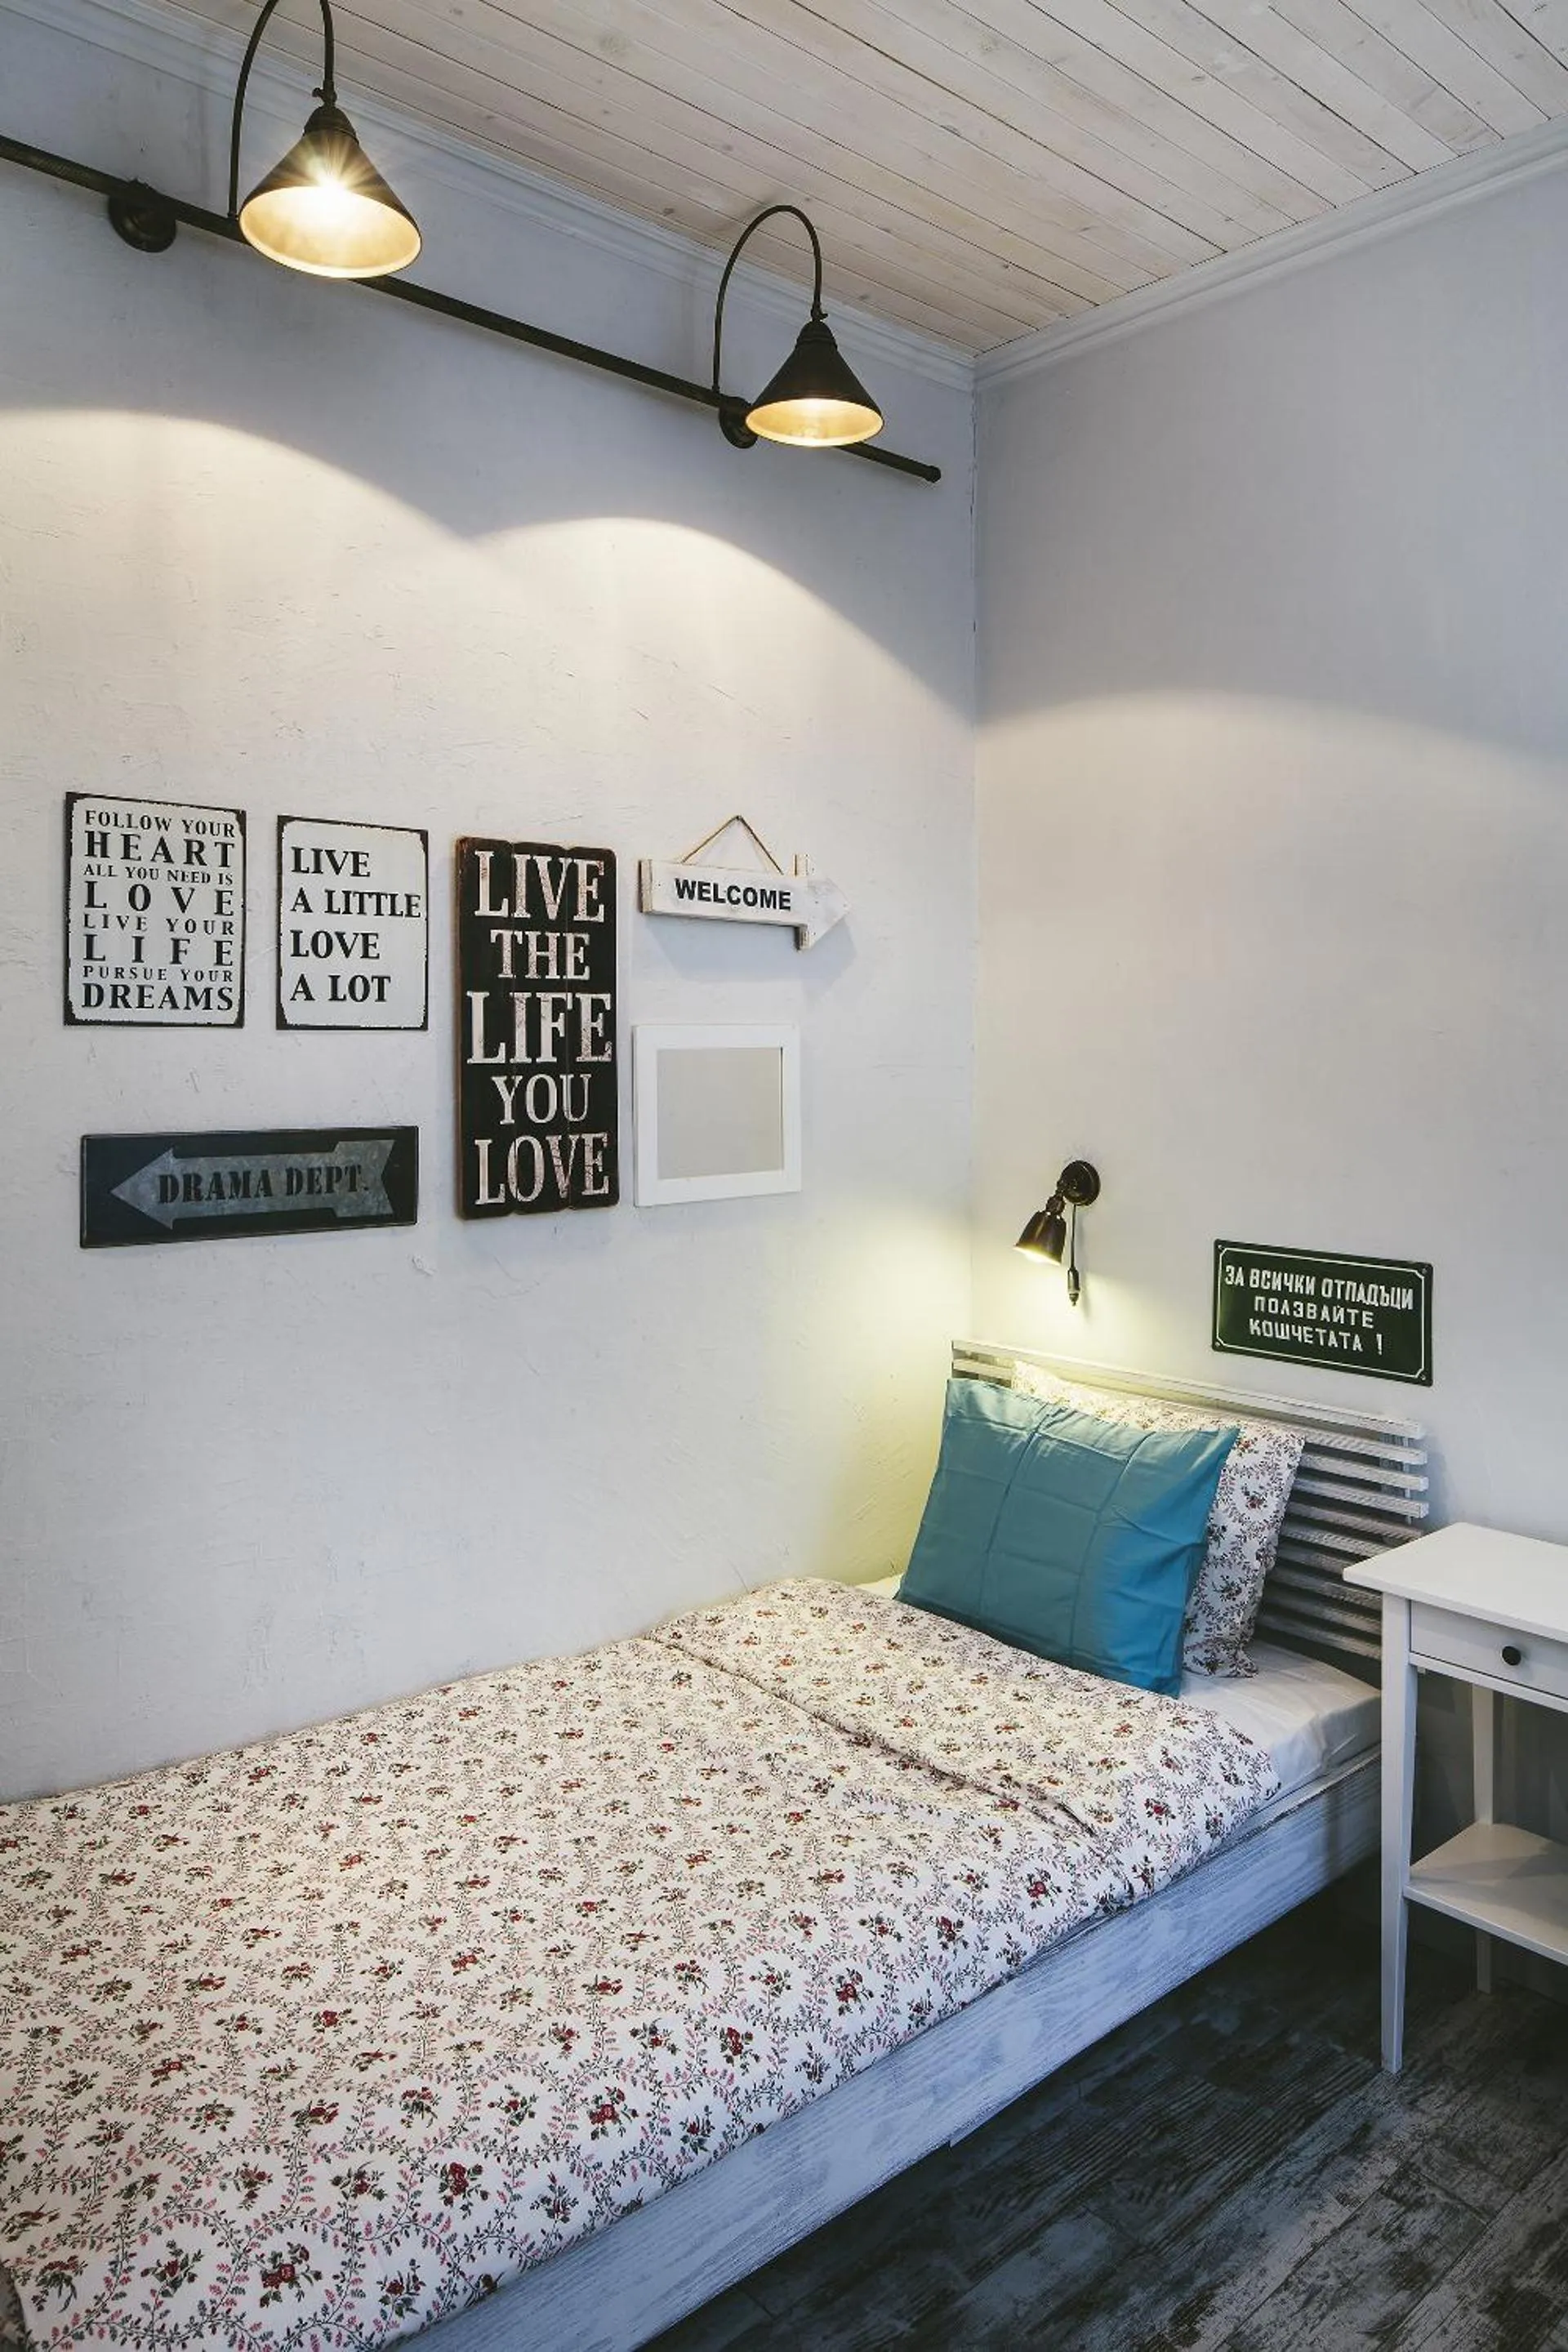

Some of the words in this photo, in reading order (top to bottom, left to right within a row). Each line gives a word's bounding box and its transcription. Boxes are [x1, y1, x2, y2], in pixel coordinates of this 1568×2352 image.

[85, 810, 172, 831] FOLLOW
[182, 820, 234, 838] YOUR
[84, 831, 234, 867] HEART
[292, 847, 370, 877] LIVE
[83, 864, 118, 877] ALL
[125, 866, 159, 880] YOU
[167, 870, 210, 884] NEED
[218, 874, 233, 885] IS
[474, 851, 605, 922] LIVE
[84, 880, 234, 916] LOVE
[290, 887, 313, 913] A
[324, 889, 421, 918] LITTLE
[675, 878, 791, 911] WELCOME
[83, 914, 148, 931] LIVE
[166, 919, 234, 935] YOUR
[83, 934, 233, 966] LIFE
[290, 929, 380, 959] LOVE
[490, 929, 590, 980] THE
[83, 966, 167, 981] PURSUE
[181, 969, 233, 982] YOUR
[290, 973, 315, 1001] A
[328, 974, 390, 1002] LOT
[82, 983, 234, 1010] DREAMS
[466, 991, 612, 1063] LIFE
[492, 1074, 592, 1125] YOU
[474, 1133, 609, 1205] LOVE
[157, 1169, 273, 1204] DRAMA
[1225, 1265, 1244, 1286] ЗА
[1250, 1268, 1316, 1296] ВСИЧКИ
[1321, 1278, 1414, 1310] ОТПАДЪЦИ
[1254, 1296, 1374, 1329] ПОЛЗВАЙТЕ
[1249, 1319, 1363, 1352] КОШЧЕТАТА
